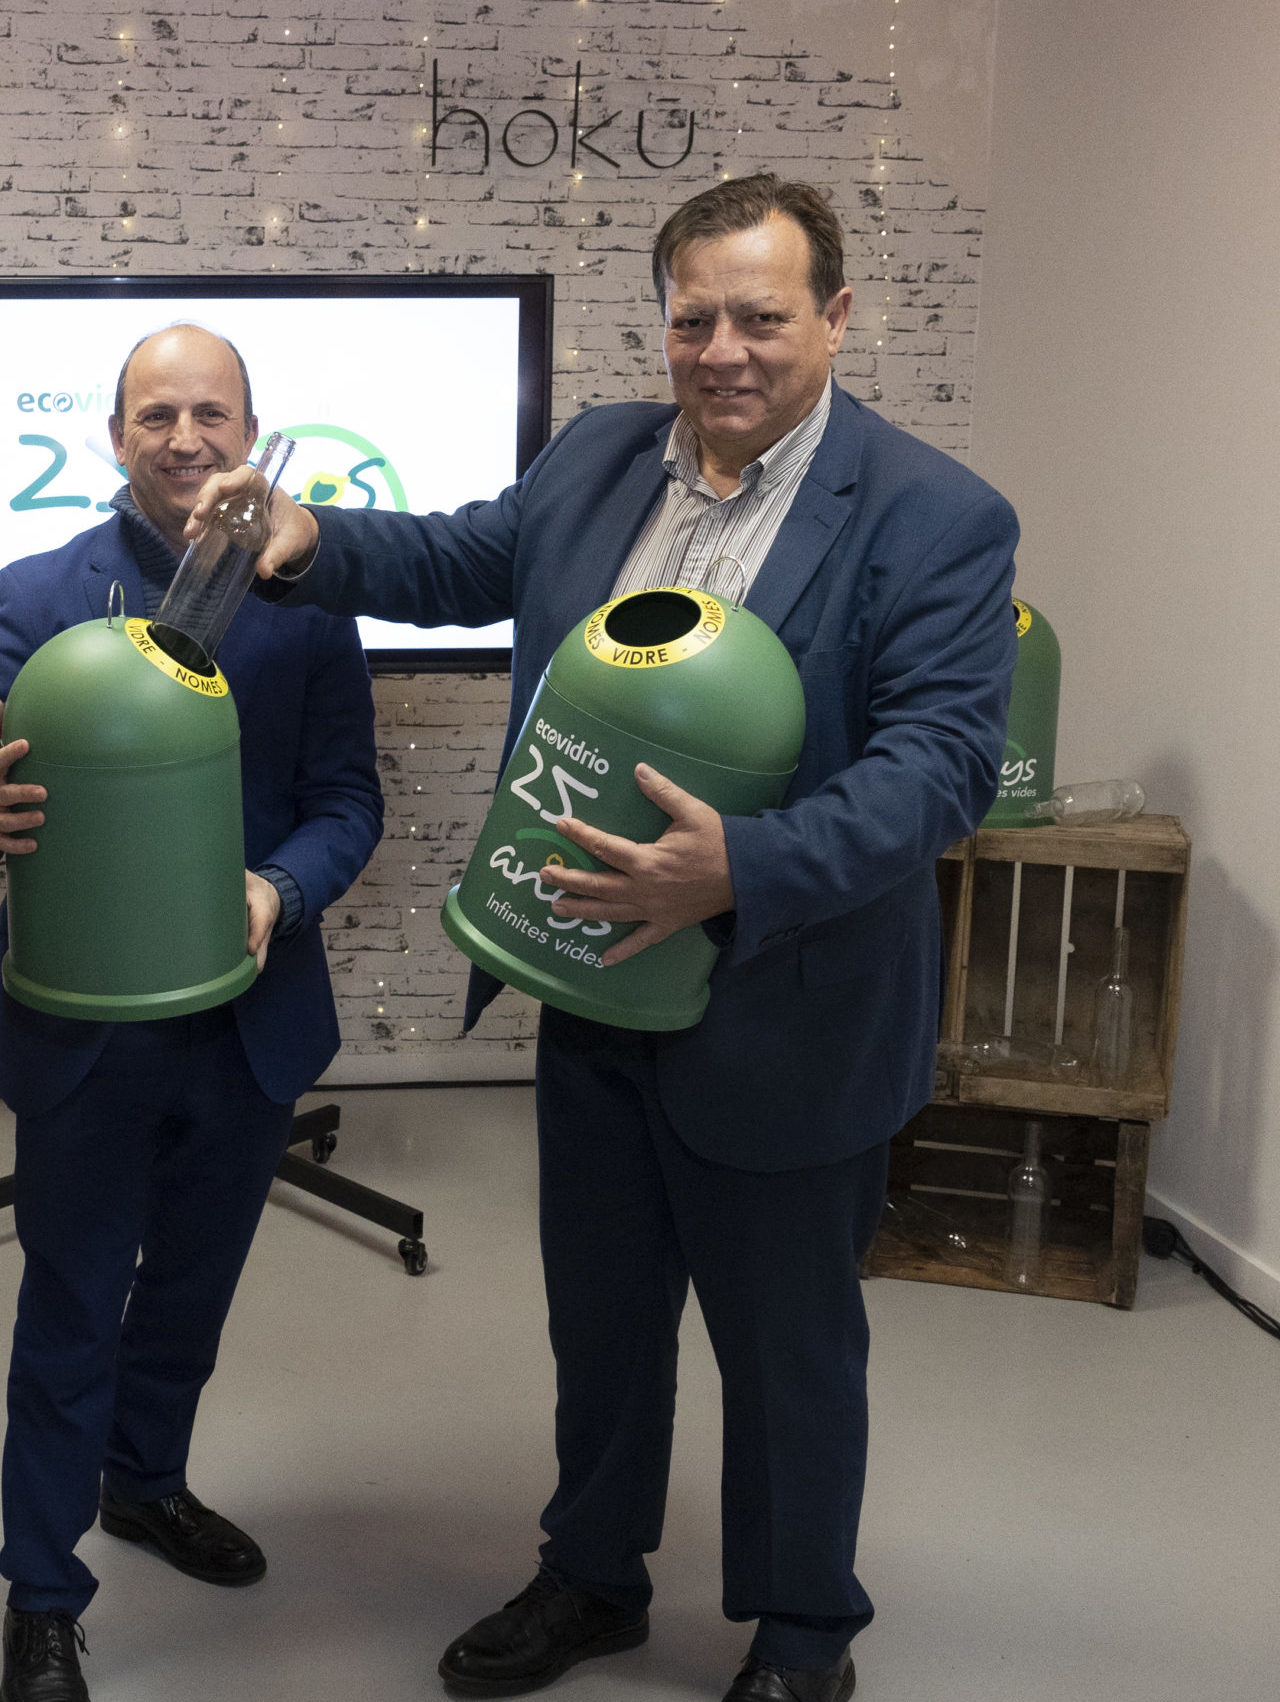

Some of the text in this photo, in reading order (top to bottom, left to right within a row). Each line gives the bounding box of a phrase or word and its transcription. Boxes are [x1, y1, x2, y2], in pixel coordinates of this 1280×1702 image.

[611, 647, 669, 665] VIDRE
[535, 718, 610, 775] ecovidrio
[510, 744, 599, 825] 25
[1011, 786, 1038, 798] vides
[485, 892, 605, 969] Infinites vides
